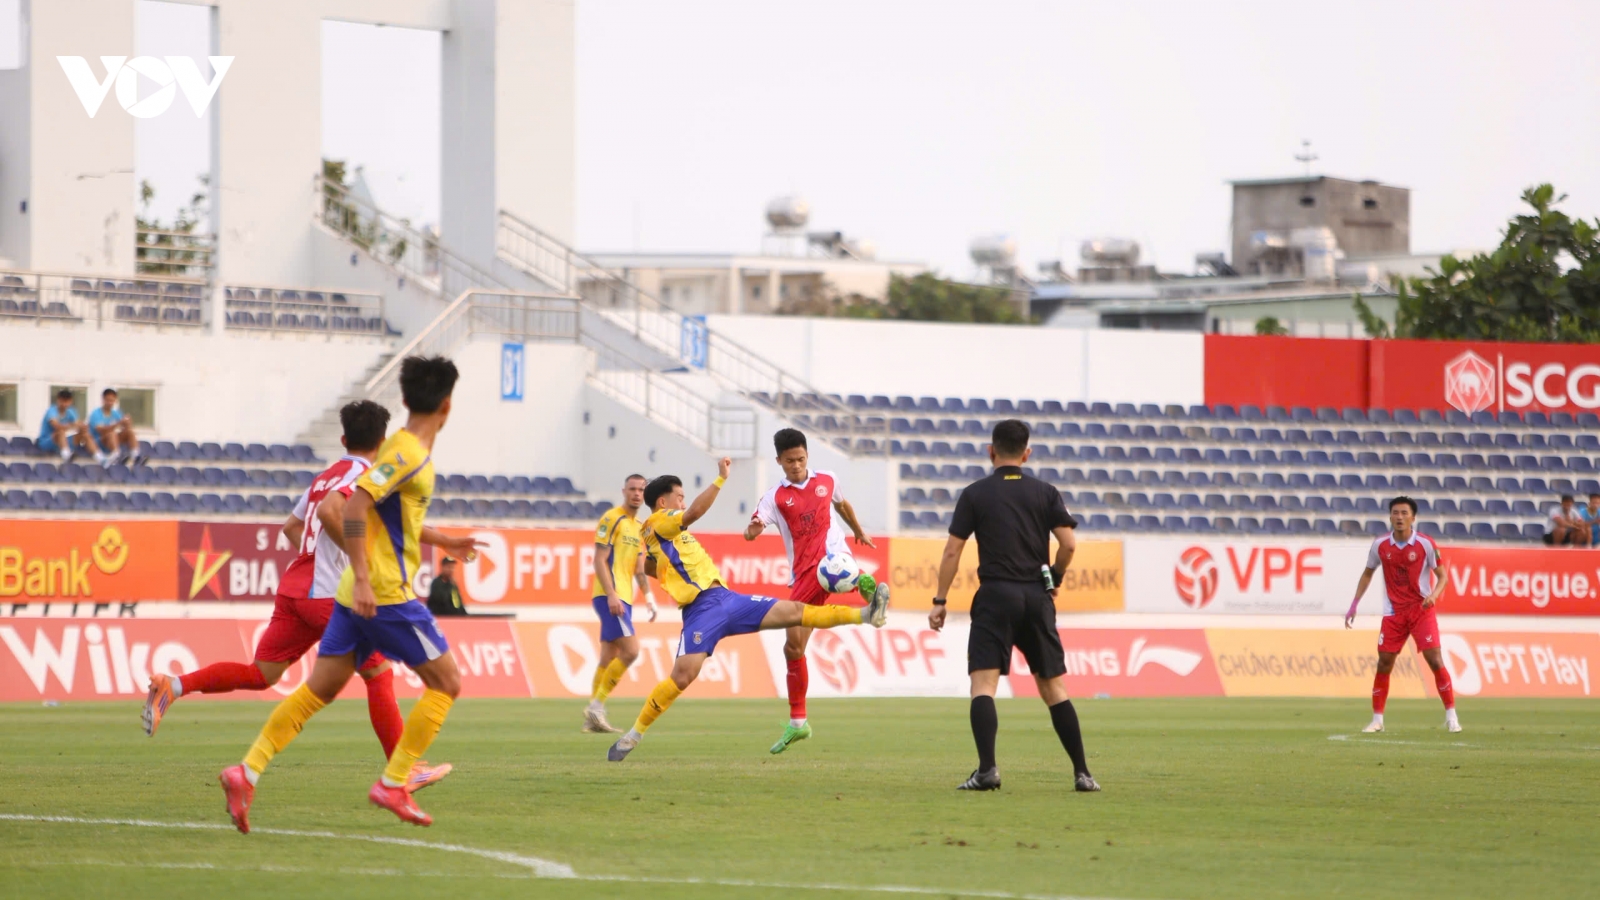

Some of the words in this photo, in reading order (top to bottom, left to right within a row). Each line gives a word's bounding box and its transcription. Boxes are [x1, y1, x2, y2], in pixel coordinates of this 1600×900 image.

[1506, 362, 1600, 409] SCG
[0, 548, 92, 597] Bank
[229, 559, 280, 596] BIA
[514, 545, 569, 590] FPT
[1065, 568, 1121, 591] BANK
[1225, 546, 1323, 594] VPF
[1450, 565, 1600, 608] V.League.
[850, 628, 946, 677] VPF
[1476, 644, 1531, 684] FPT
[1530, 645, 1591, 695] Play
